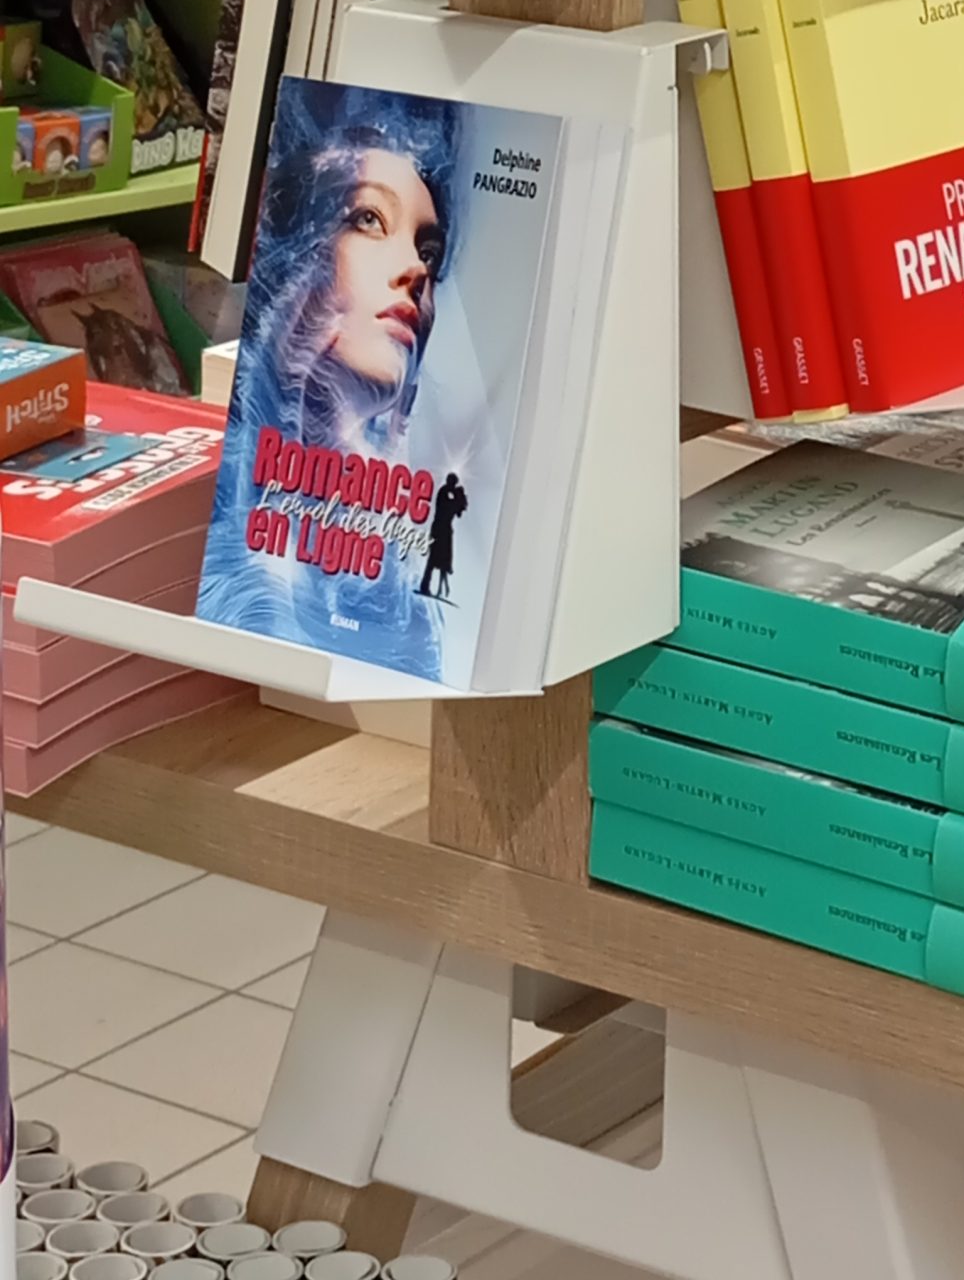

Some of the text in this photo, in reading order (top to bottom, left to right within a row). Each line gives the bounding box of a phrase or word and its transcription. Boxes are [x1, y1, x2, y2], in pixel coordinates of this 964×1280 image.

[492, 147, 543, 173] Delphine
[472, 171, 538, 200] PANGRAZIO
[851, 337, 870, 388] GRASSET
[253, 424, 435, 525] Romance
[718, 473, 822, 530] MARTIN
[751, 478, 860, 541] LUGAND
[245, 506, 385, 582] en Ligne
[838, 642, 922, 680] Renaissances
[835, 728, 919, 767] Renaissances
[828, 821, 911, 861] Renaissances
[827, 904, 909, 944] Renaissances
